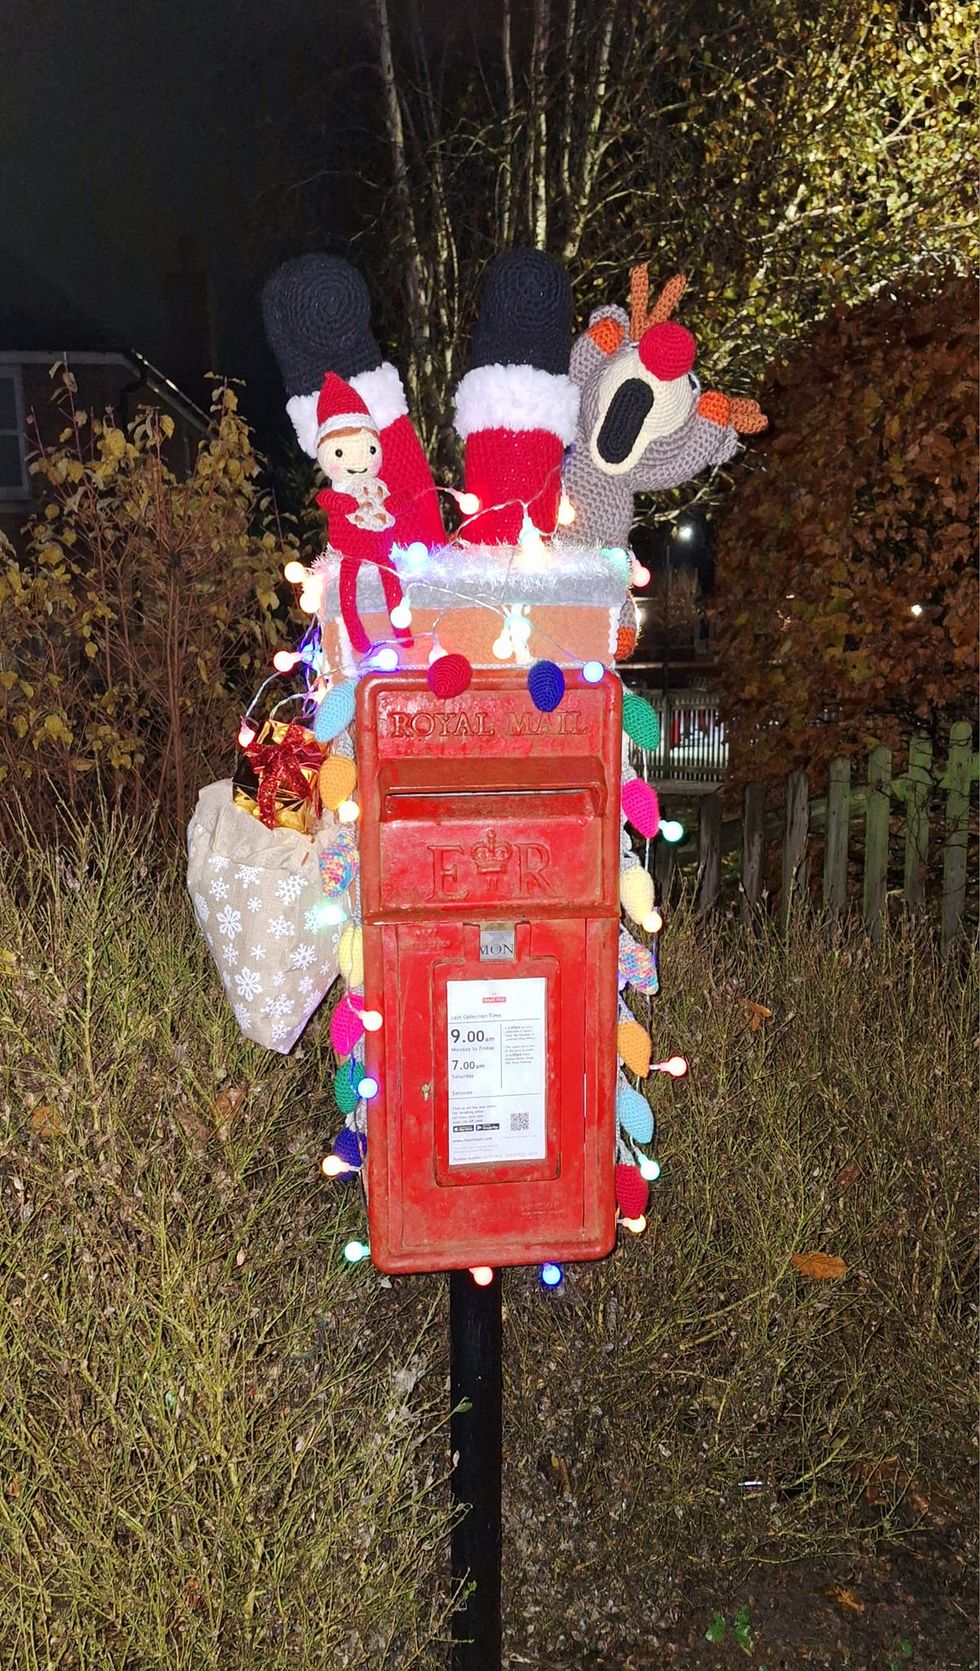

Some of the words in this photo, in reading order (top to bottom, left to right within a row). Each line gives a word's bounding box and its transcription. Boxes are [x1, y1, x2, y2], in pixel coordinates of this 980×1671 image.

[391, 711, 495, 737] ROYAL
[504, 710, 589, 736] MAIL
[427, 844, 470, 900] E
[514, 842, 562, 899] R
[479, 943, 514, 956] MON
